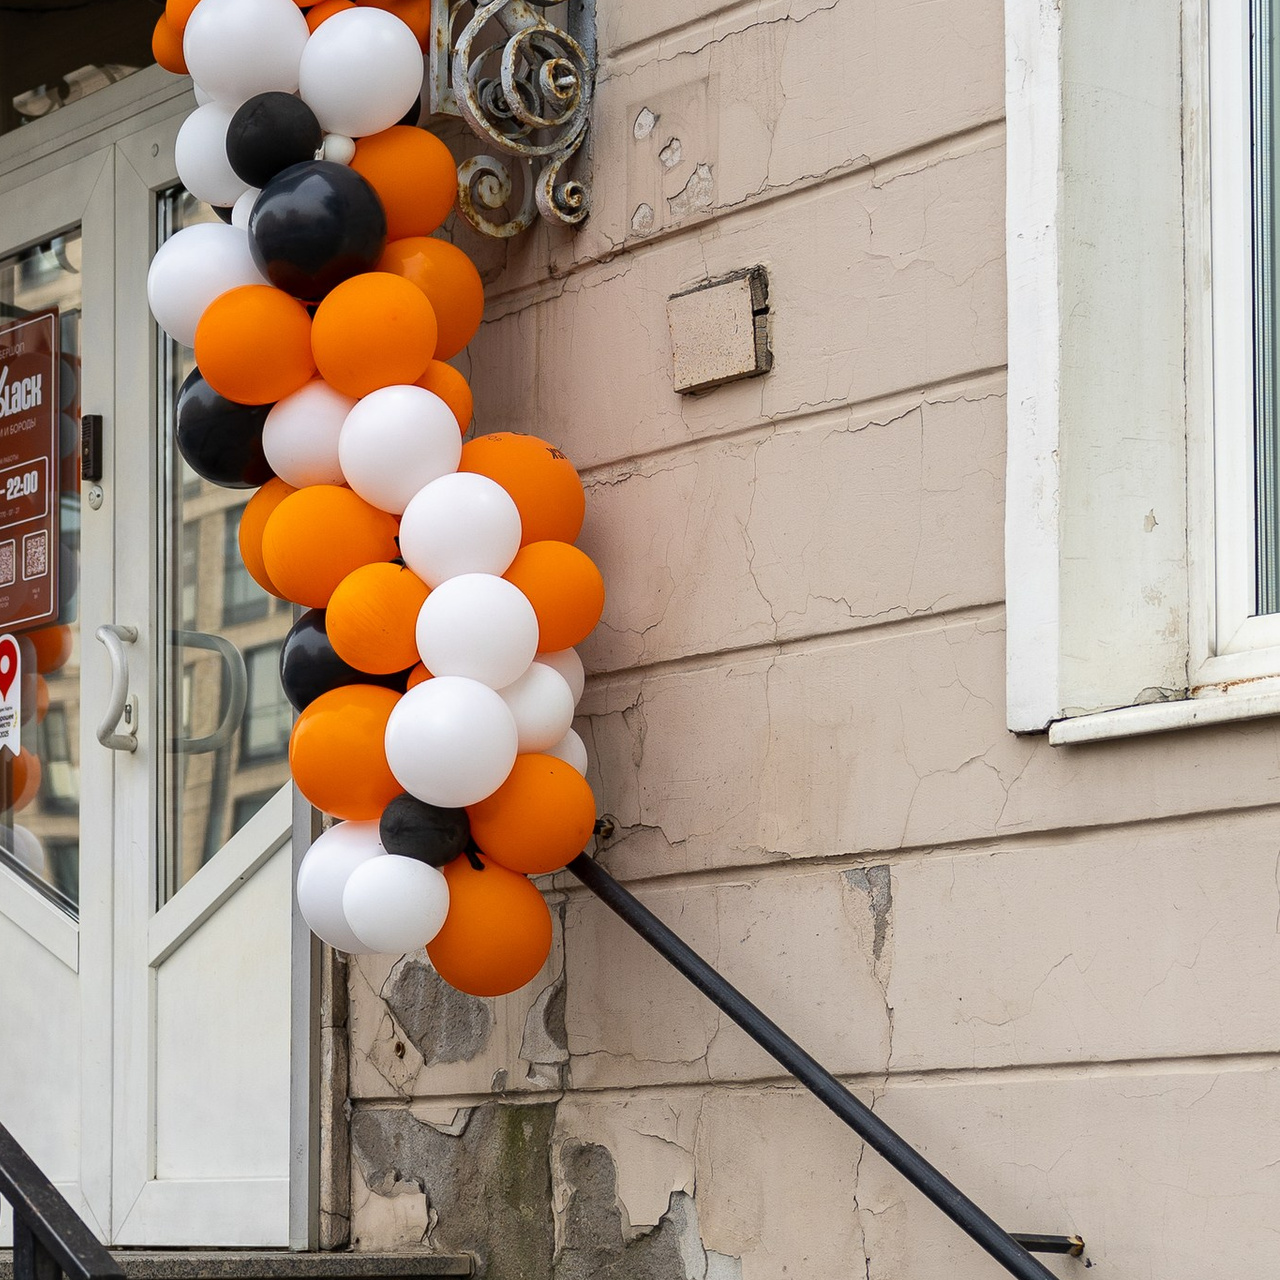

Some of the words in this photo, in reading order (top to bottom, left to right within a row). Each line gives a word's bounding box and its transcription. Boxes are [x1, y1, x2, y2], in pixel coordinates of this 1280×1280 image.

[3, 426, 10, 437] И
[9, 417, 37, 435] БОРОДЫ
[6, 470, 39, 501] 22:00
